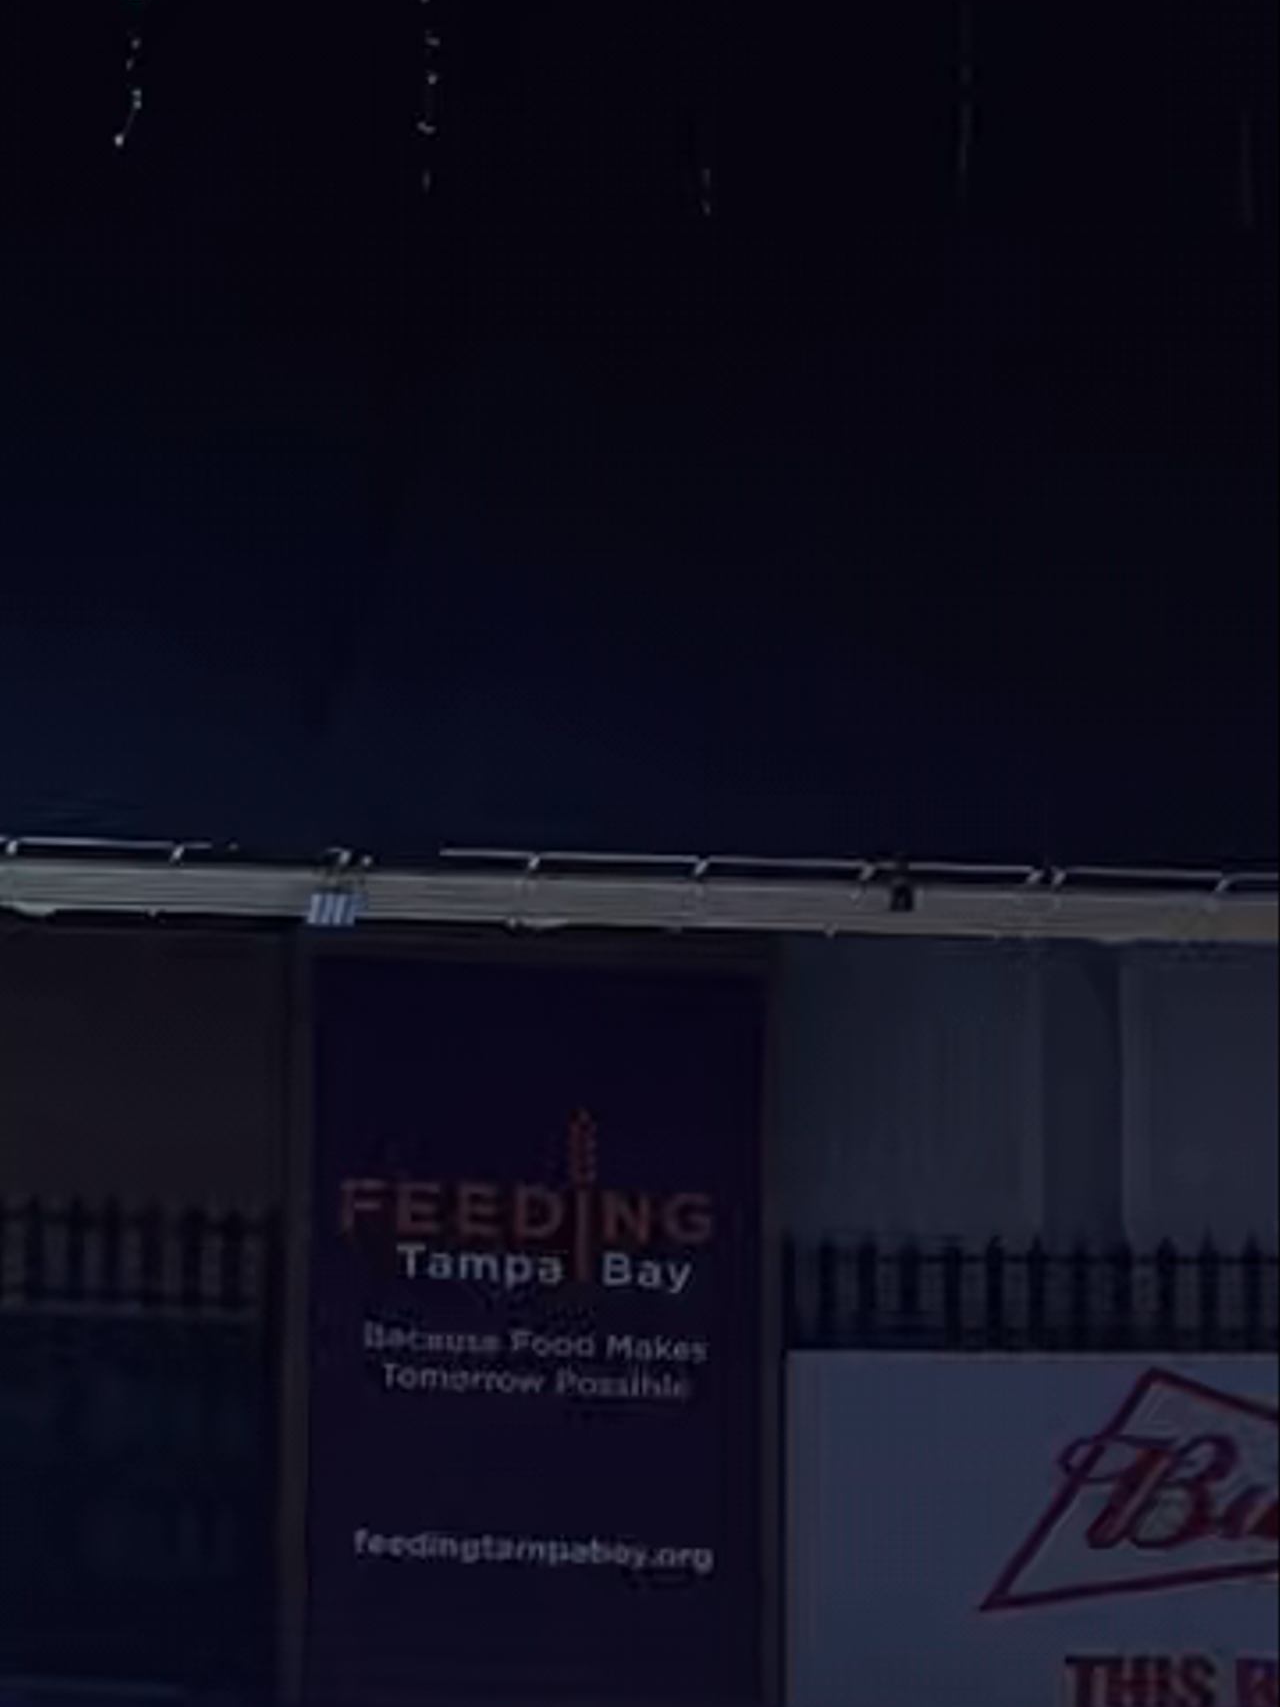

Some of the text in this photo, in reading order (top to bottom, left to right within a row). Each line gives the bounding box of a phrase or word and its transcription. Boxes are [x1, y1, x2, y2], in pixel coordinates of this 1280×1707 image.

[338, 1177, 716, 1281] FEEDING
[396, 1240, 697, 1295] Tampa Bay
[362, 1317, 712, 1364] Because Food Makes
[381, 1360, 690, 1398] Tomorrow Possible
[351, 1525, 716, 1576] feedingtampabay.org
